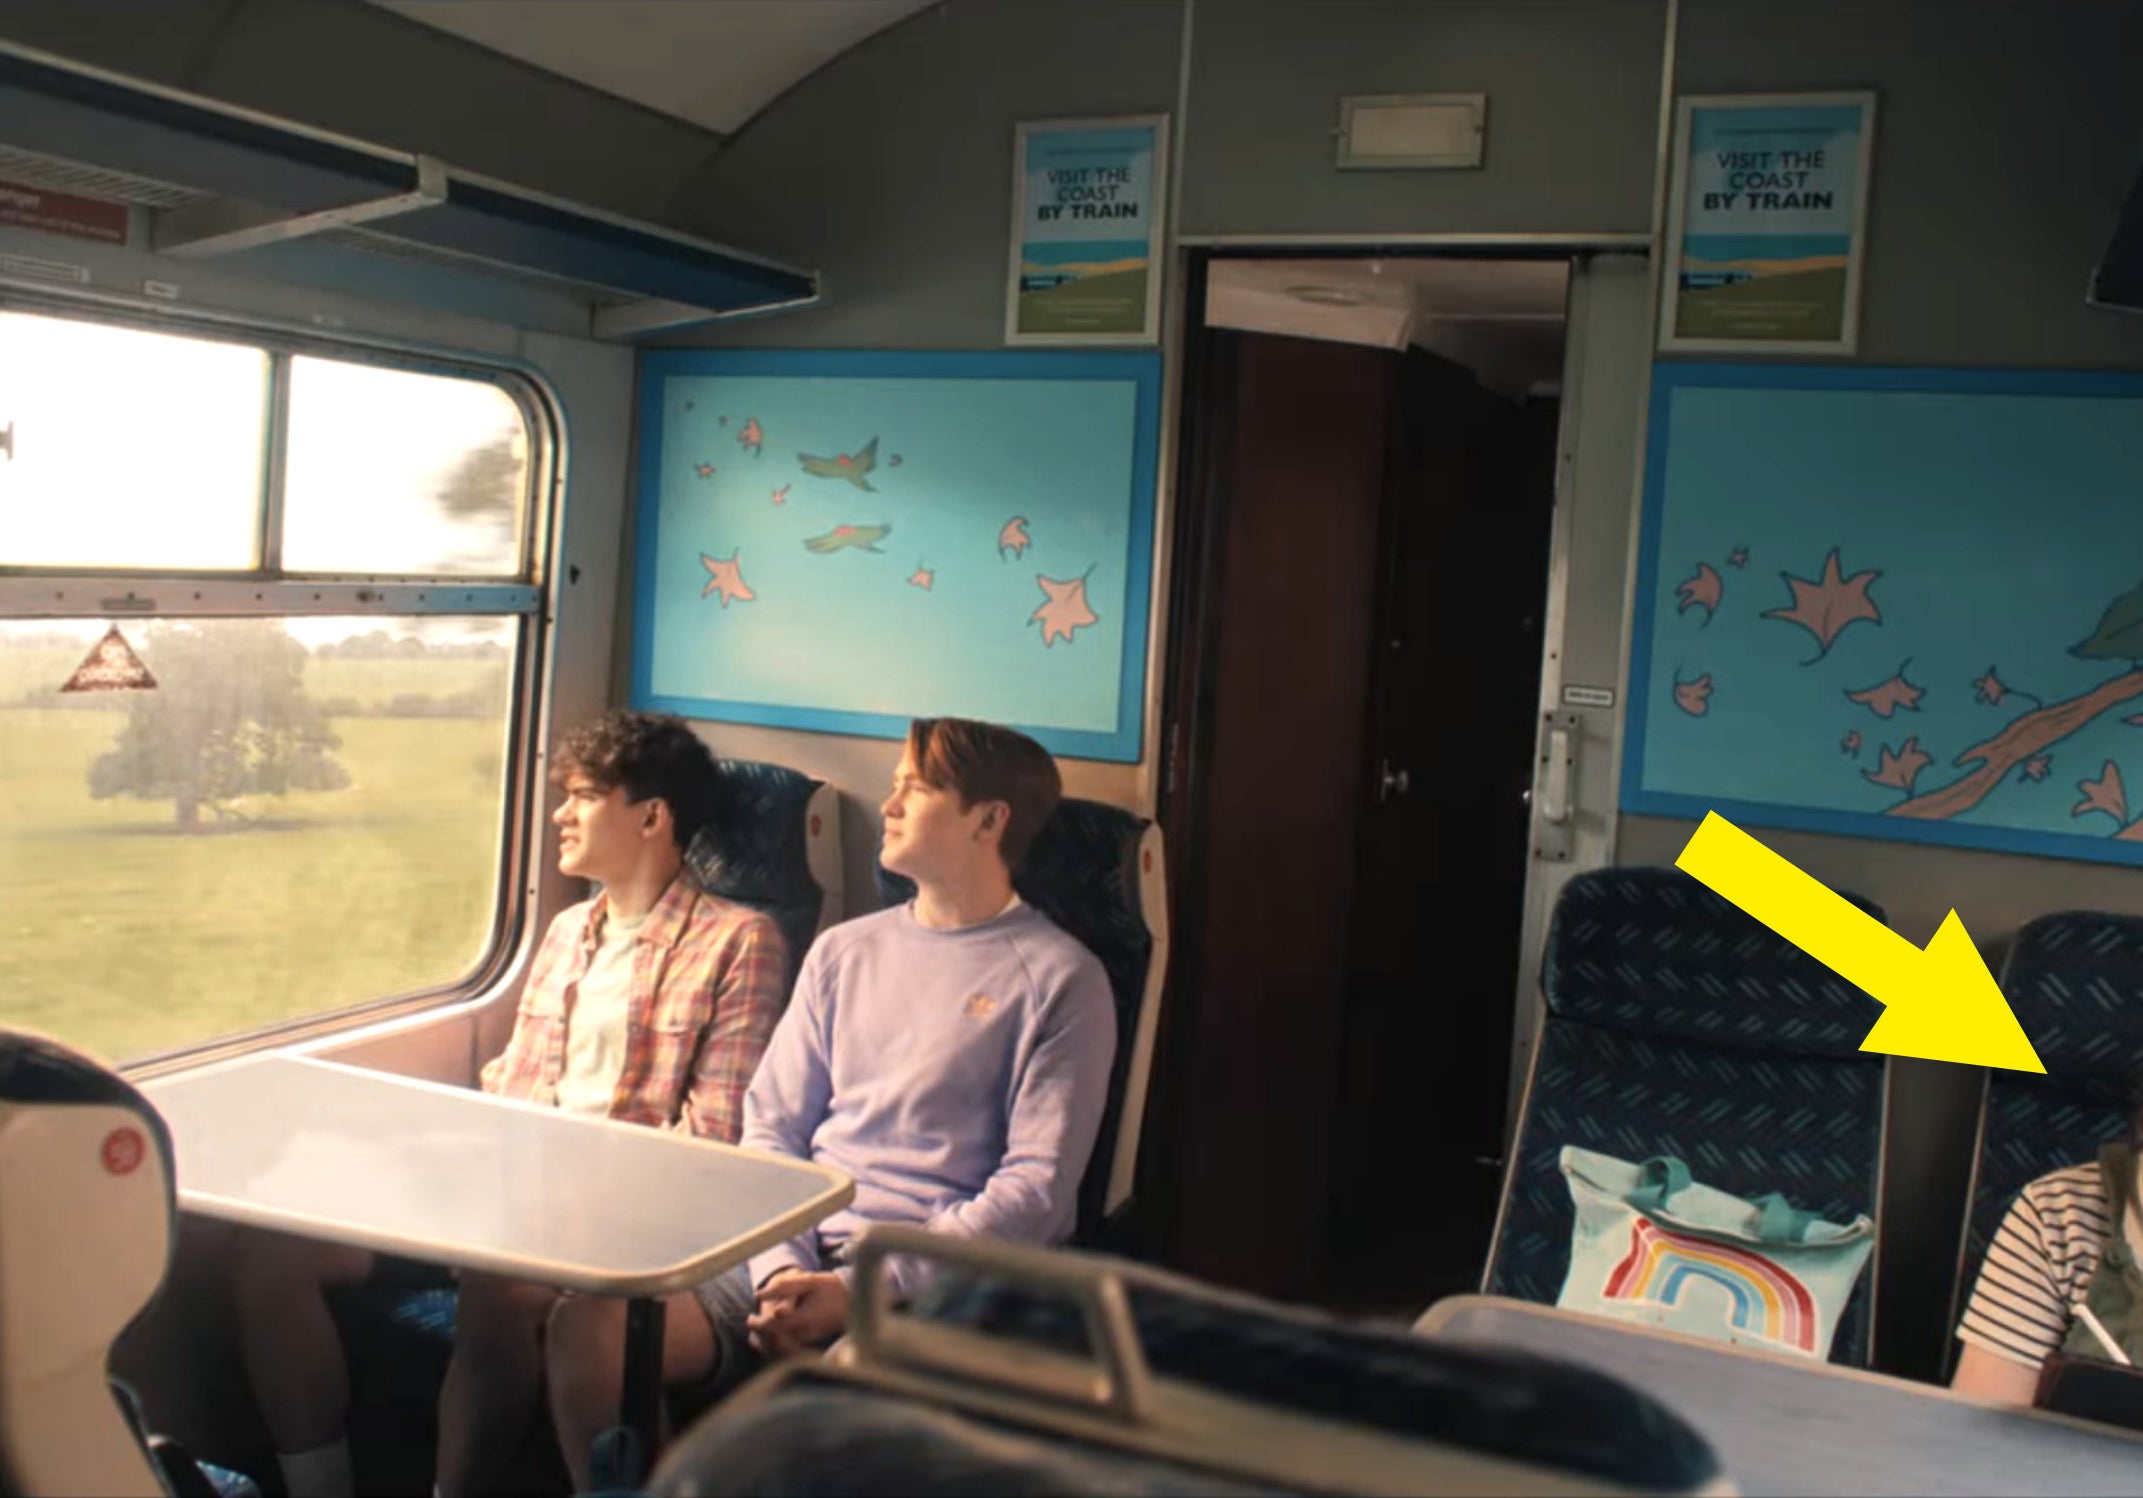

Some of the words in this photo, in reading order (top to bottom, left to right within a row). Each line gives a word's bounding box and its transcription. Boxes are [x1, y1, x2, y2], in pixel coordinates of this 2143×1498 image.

[1716, 151, 1772, 169] VISIT
[1780, 150, 1826, 168] THE
[1048, 169, 1089, 184] VISIT
[1096, 167, 1131, 183] THE
[1728, 170, 1810, 190] COAST
[1056, 185, 1120, 202] COAST
[1703, 192, 1738, 210] BY
[1745, 191, 1834, 210] TRAIN
[1037, 205, 1064, 221] BY
[1070, 202, 1138, 219] TRAIN
